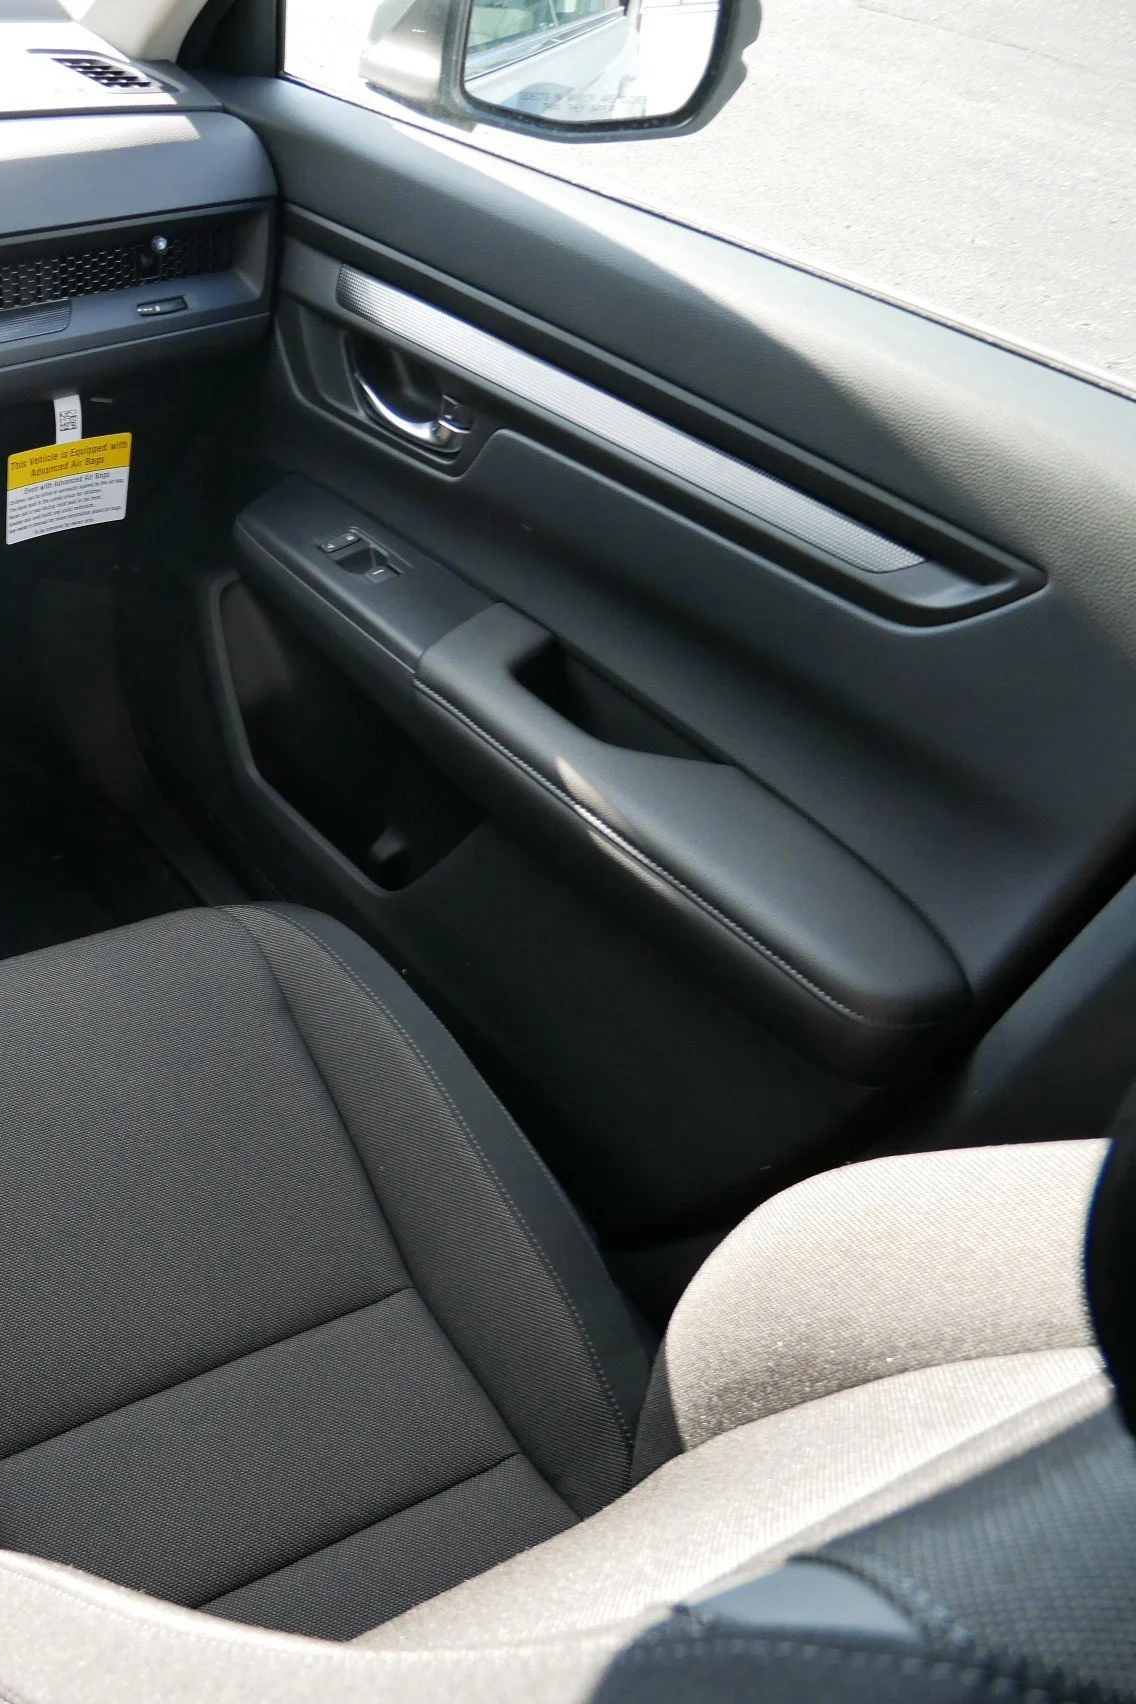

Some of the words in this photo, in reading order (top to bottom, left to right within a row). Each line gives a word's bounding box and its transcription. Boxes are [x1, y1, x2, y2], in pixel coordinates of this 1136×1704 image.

[10, 460, 27, 471] This
[29, 453, 58, 466] Vehicle
[61, 449, 68, 460] is
[70, 444, 108, 458] Equipped
[110, 439, 128, 450] with
[31, 461, 68, 476] Advanced
[71, 458, 82, 468] Air
[85, 455, 105, 468] Bags
